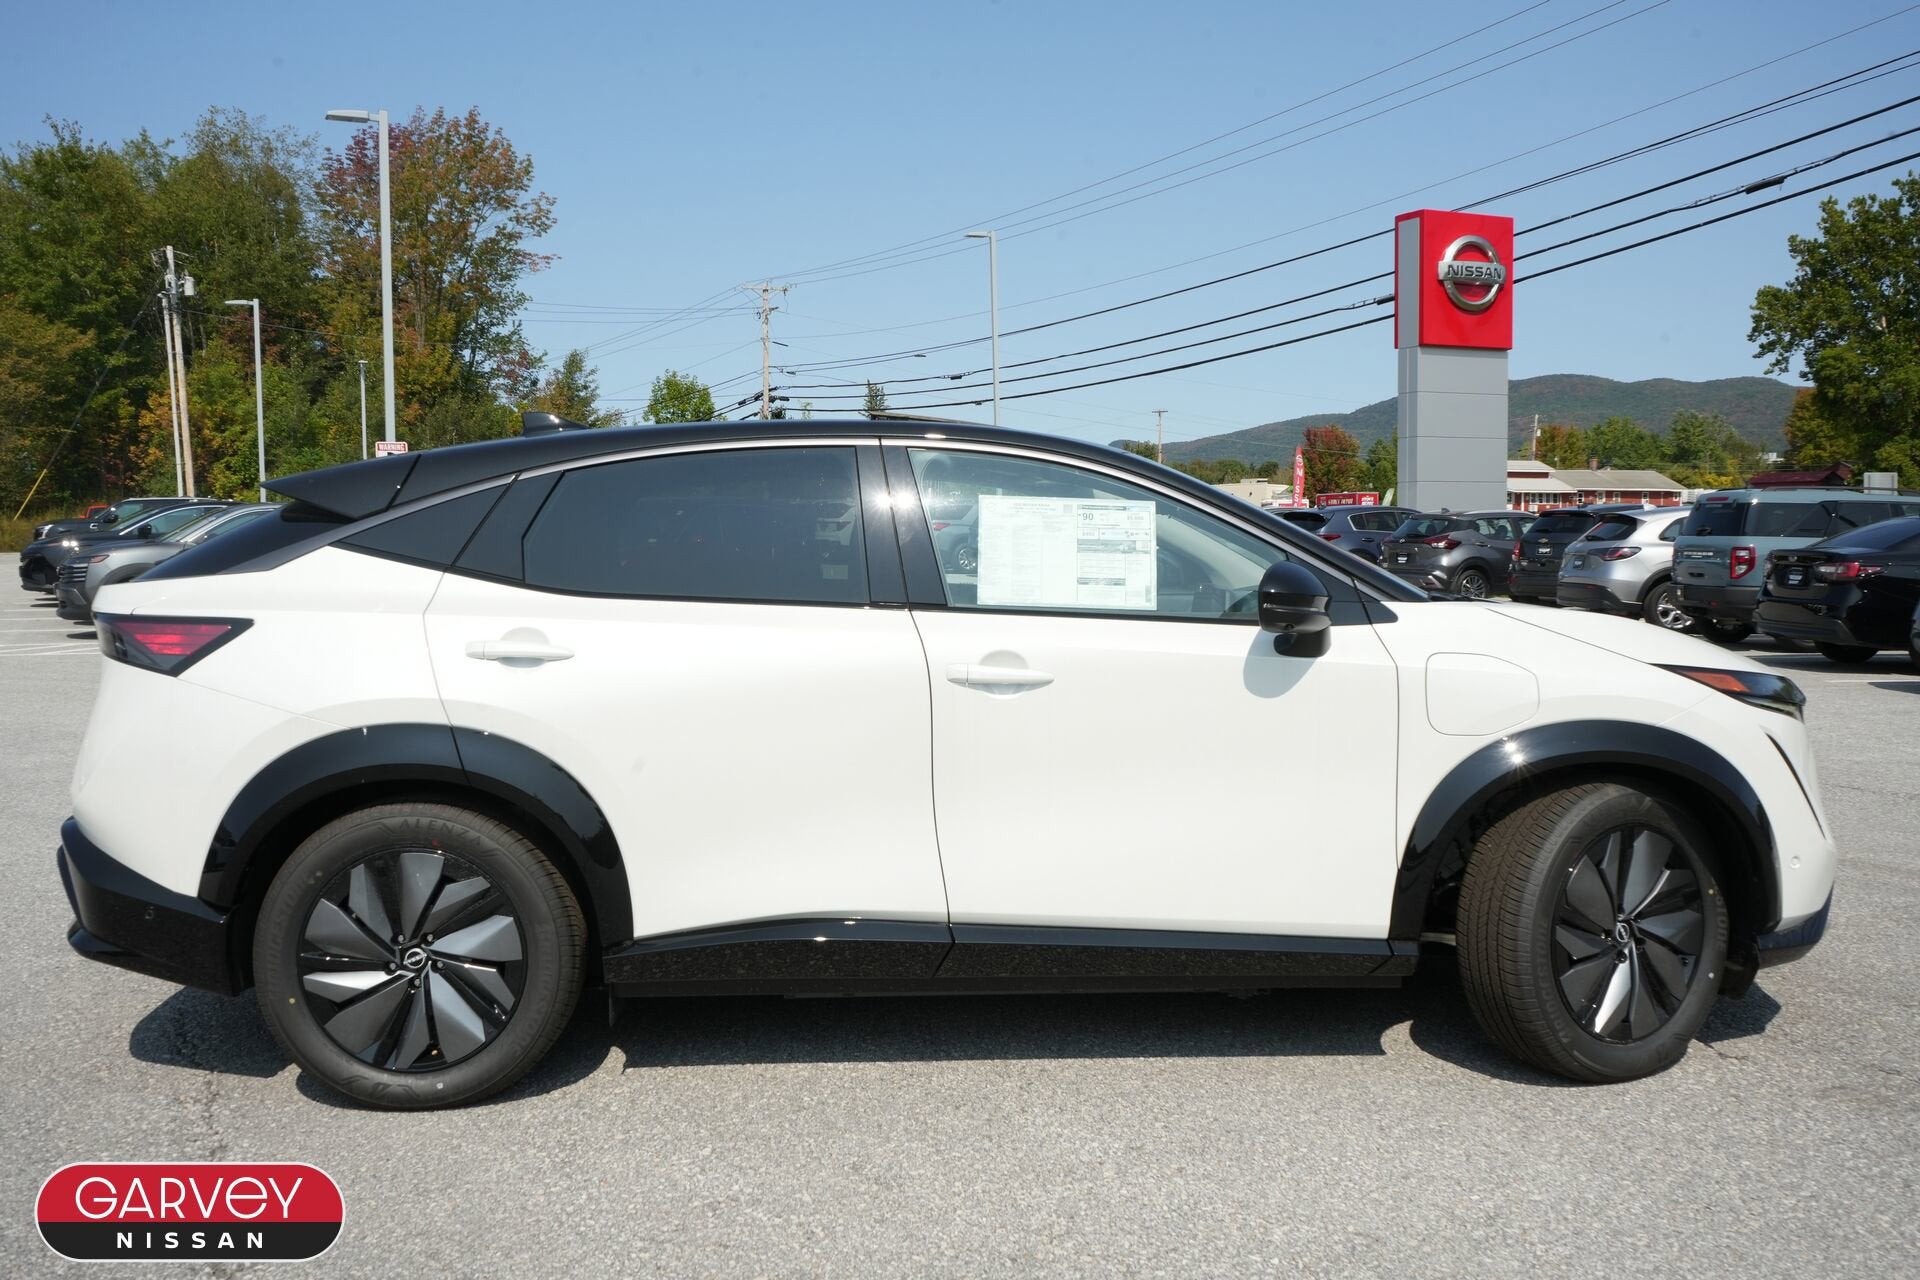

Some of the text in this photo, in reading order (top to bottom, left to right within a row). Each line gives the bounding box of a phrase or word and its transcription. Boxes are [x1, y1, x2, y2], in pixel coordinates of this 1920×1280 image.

[1447, 264, 1502, 280] NISSAN
[1293, 468, 1304, 507] NISSA
[399, 818, 483, 847] ALENZA
